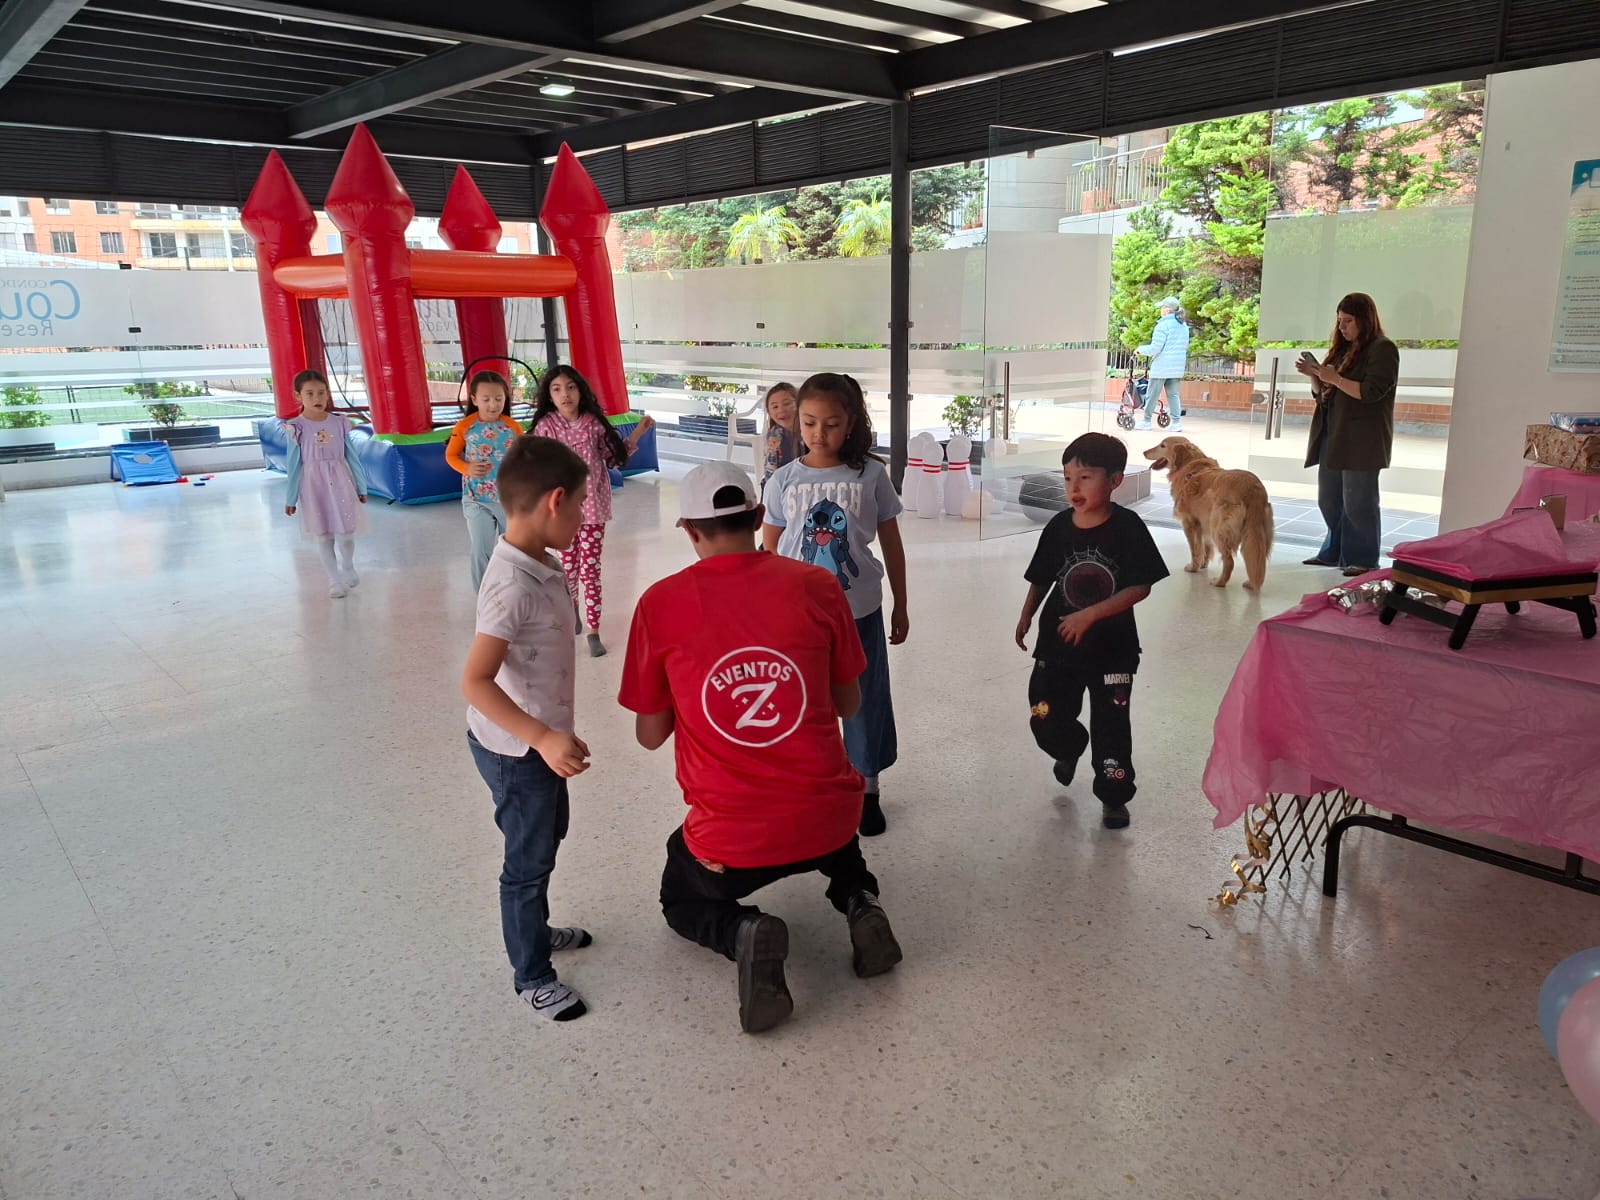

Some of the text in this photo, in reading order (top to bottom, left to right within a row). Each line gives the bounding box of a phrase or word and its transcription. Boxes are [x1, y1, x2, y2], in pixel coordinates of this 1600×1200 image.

[787, 482, 863, 518] STITCH
[710, 661, 793, 692] EVENTOS
[731, 681, 780, 729] Z
